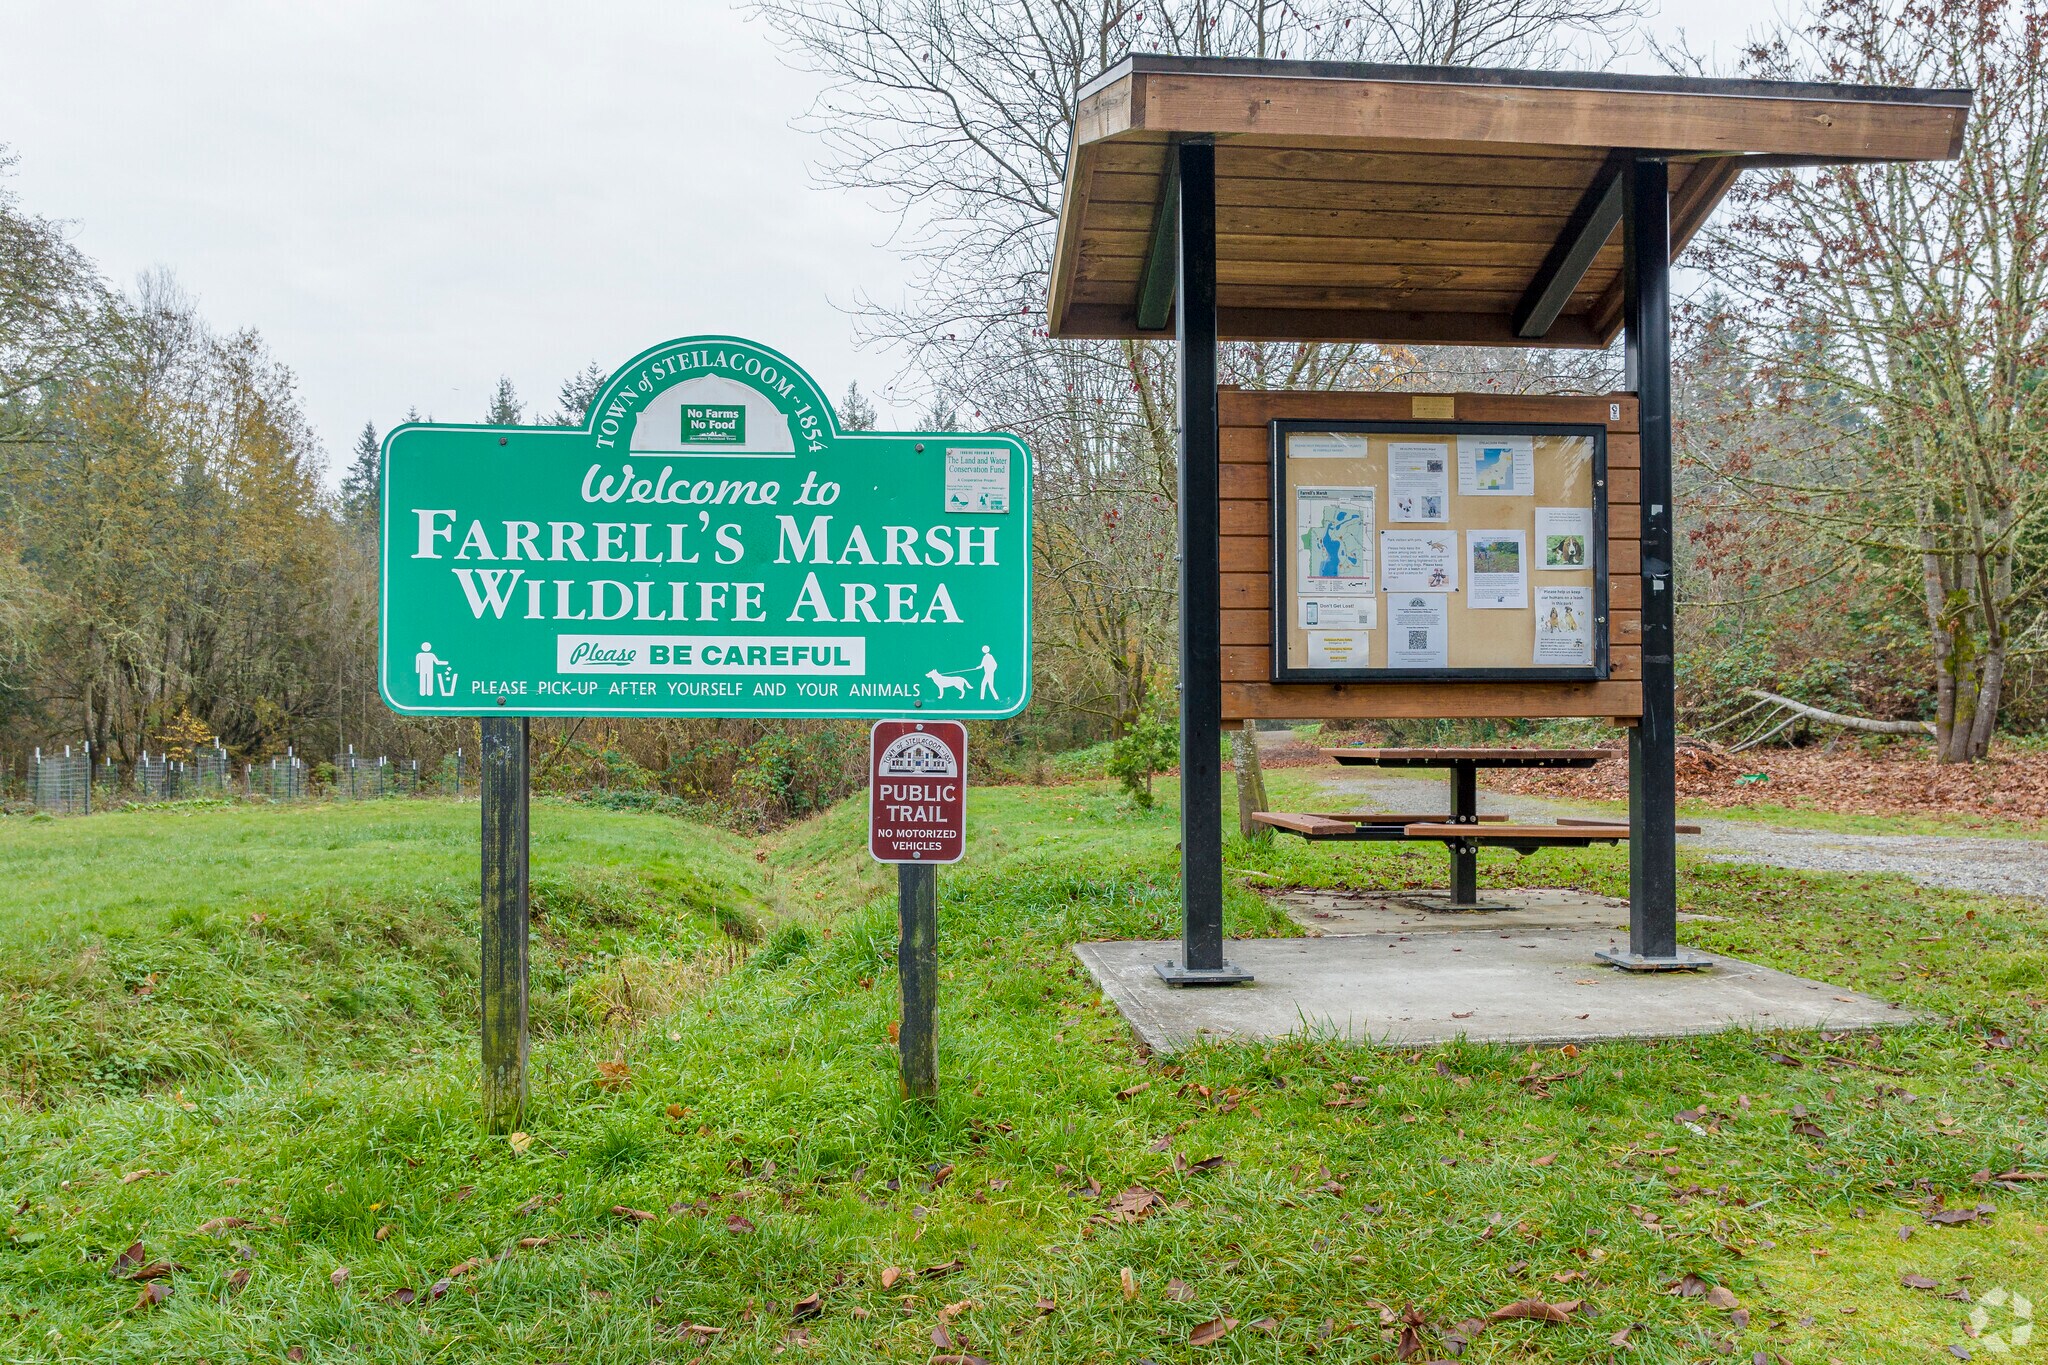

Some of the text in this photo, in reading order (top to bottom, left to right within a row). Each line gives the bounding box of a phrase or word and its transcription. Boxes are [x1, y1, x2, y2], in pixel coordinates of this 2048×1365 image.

[596, 384, 639, 448] TOWN
[638, 371, 654, 392] of
[652, 350, 795, 399] STEILACOOM
[688, 409, 739, 418] No Farms
[691, 420, 735, 429] No Food
[949, 465, 988, 473] Conservation
[581, 464, 841, 506] Welcome to
[773, 515, 1000, 567] MARSH
[451, 568, 964, 623] WILDLIFE AREA
[569, 642, 851, 666] Please BE CAREFUL
[471, 681, 920, 697] PLEASE PICK-UP AFTER YOURSELF AND YOUR ANIMALS
[880, 785, 956, 802] PUBLIC
[886, 805, 948, 823] TRAIL
[878, 829, 957, 838] NO MOTORIZED
[892, 842, 942, 851] VEHICLES
